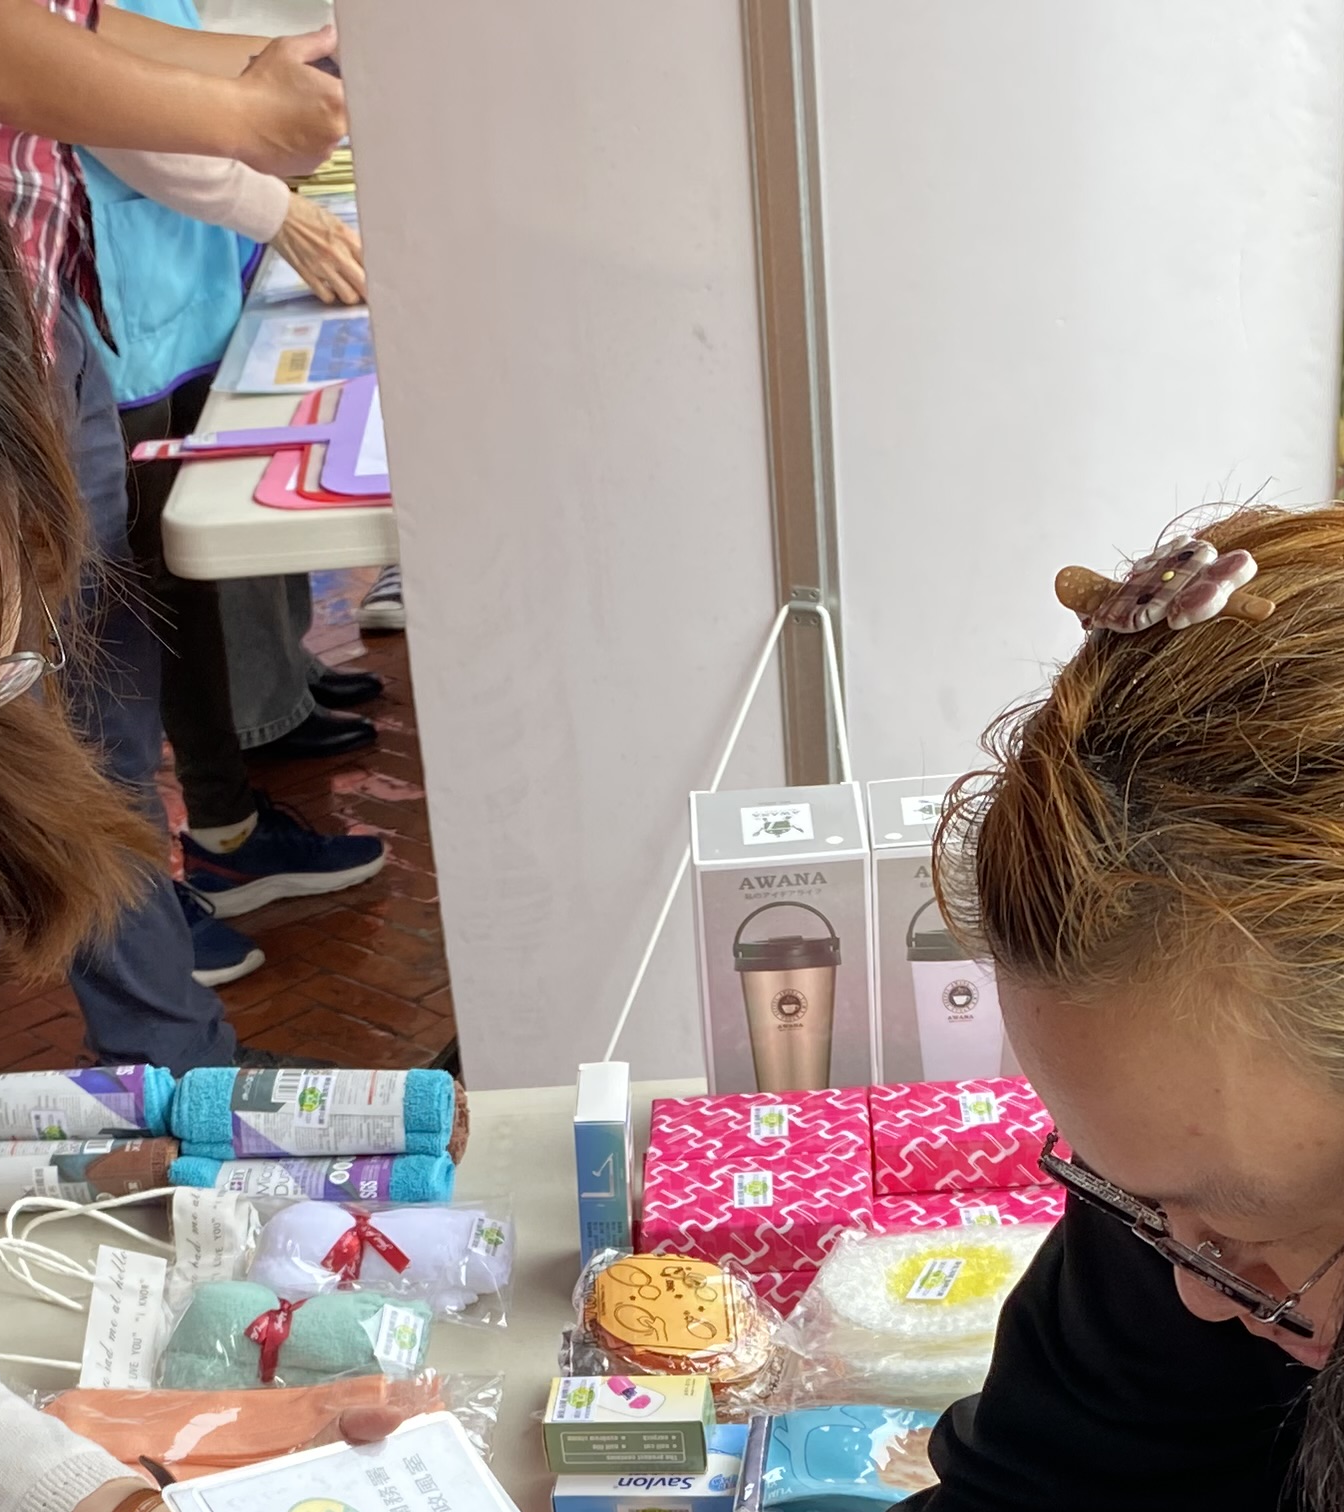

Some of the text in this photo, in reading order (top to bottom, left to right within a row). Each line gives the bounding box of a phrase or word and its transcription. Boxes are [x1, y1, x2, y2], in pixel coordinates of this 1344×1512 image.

[738, 871, 828, 891] AWANA
[359, 1180, 378, 1199] SGS
[618, 1476, 696, 1490] Savlon
